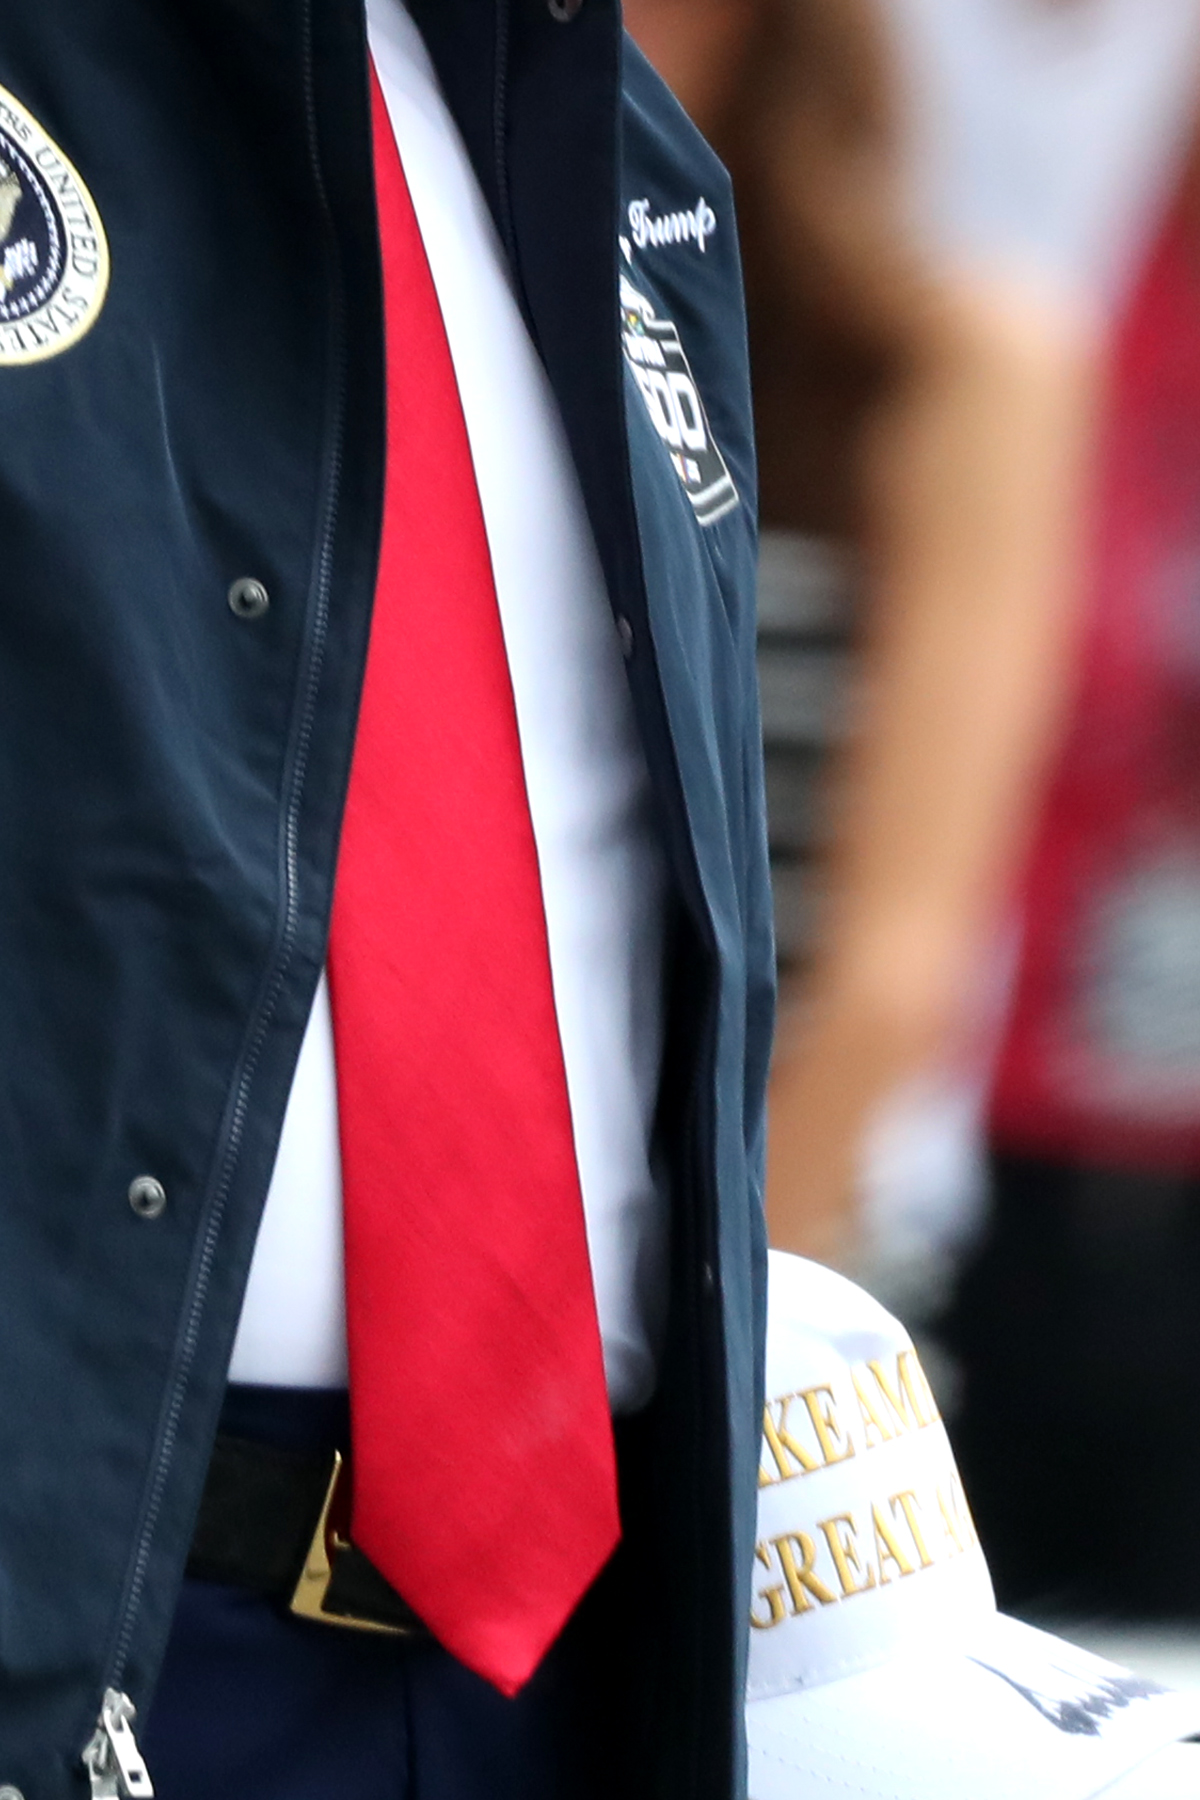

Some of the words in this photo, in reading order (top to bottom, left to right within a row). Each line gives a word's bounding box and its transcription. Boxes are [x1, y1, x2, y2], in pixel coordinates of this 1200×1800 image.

[35, 145, 99, 277] UNITED
[628, 197, 717, 253] Trump
[757, 1382, 856, 1490] KE
